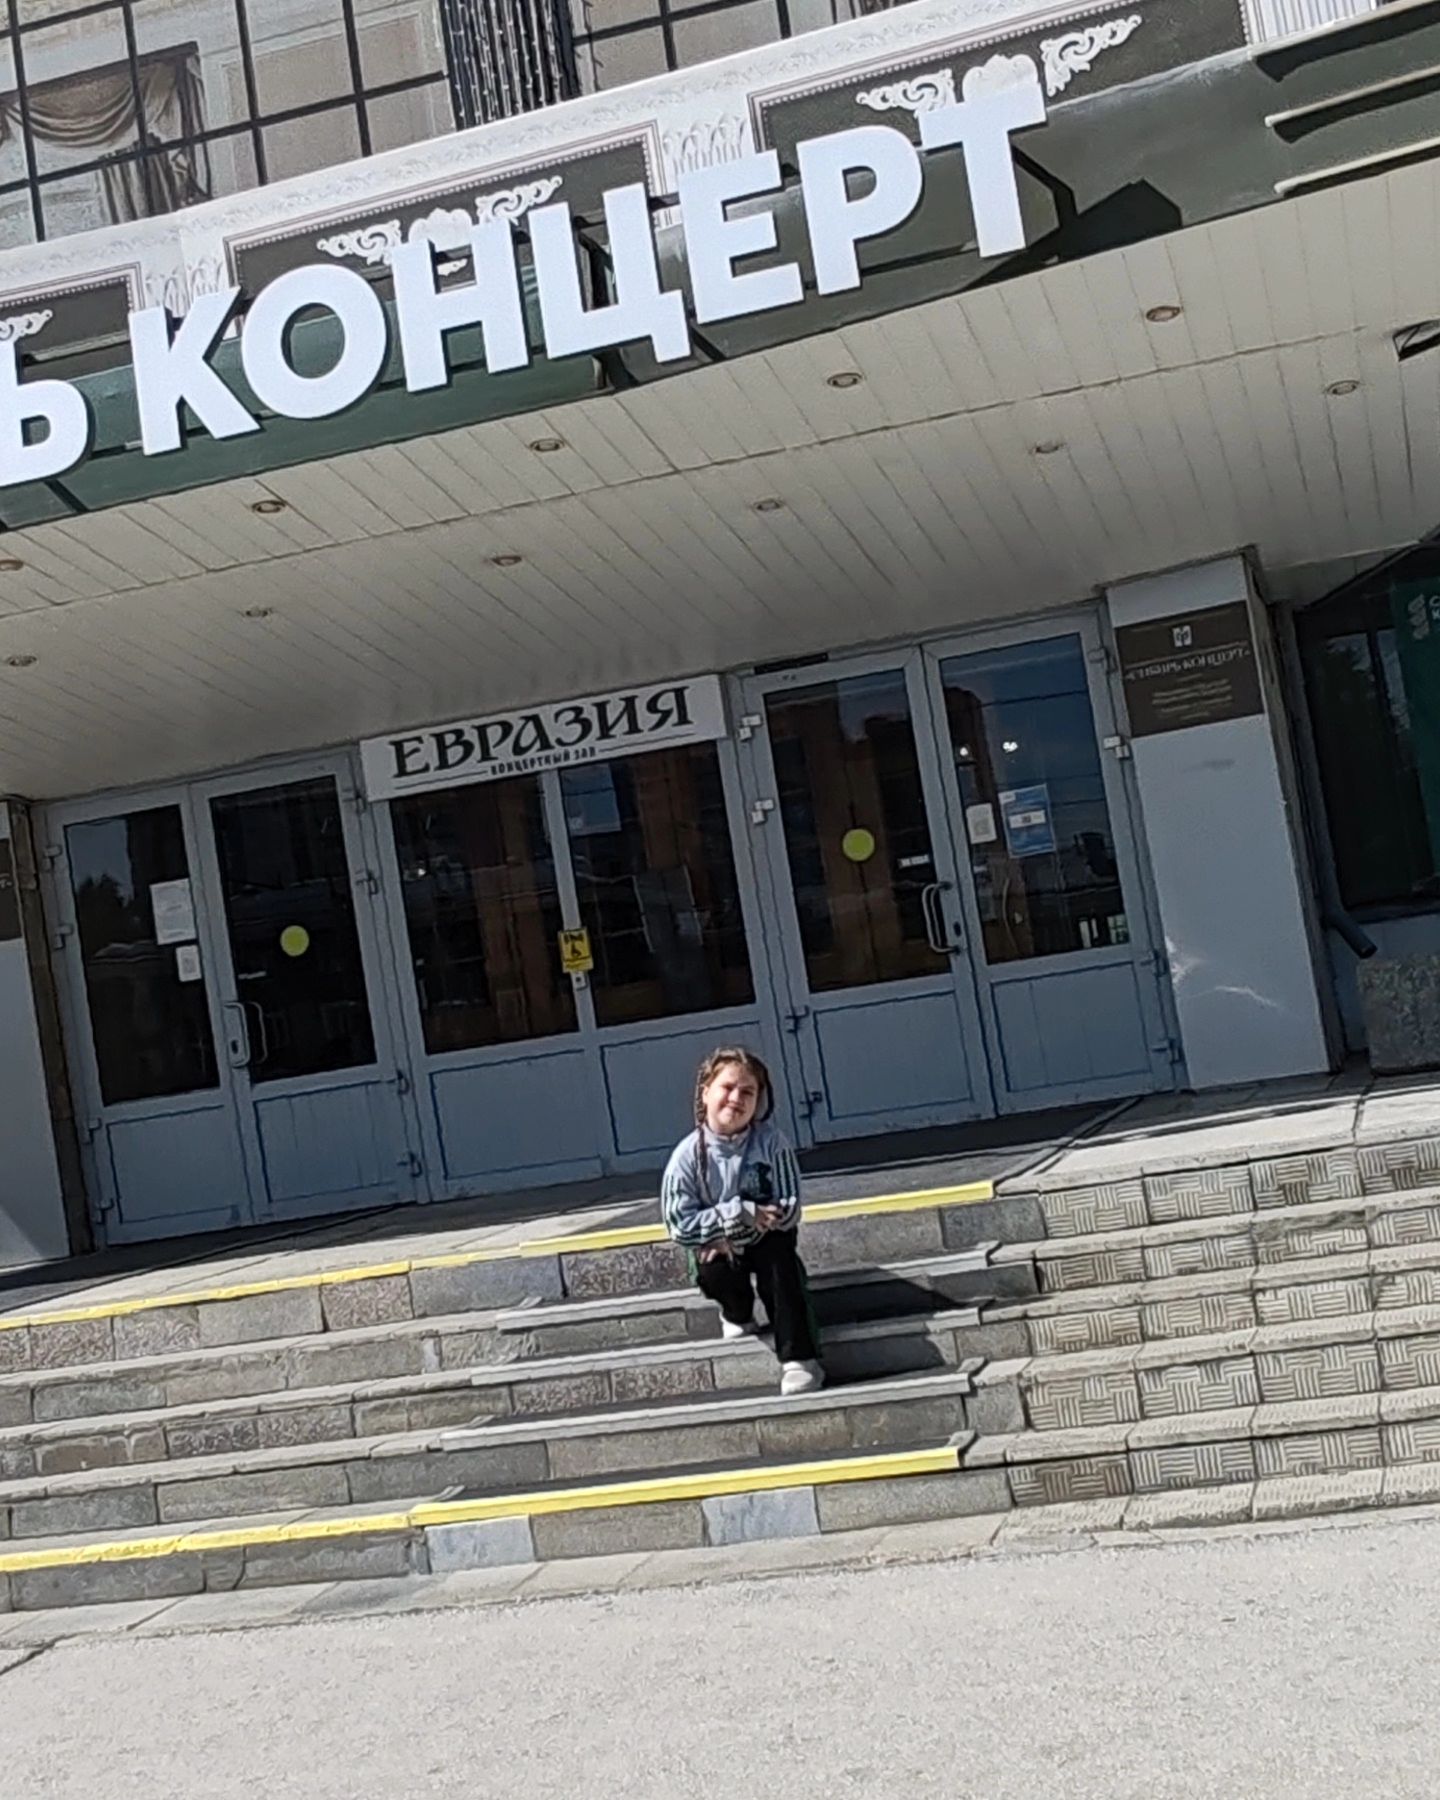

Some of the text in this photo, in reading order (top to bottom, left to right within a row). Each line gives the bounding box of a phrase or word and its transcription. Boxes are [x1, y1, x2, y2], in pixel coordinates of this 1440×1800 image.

[128, 80, 1047, 456] КОНЦЕРТ
[389, 684, 693, 778] ЕВРАЗИЯ
[491, 746, 597, 776] КОНЦЕРТНЫЙ ЗАЛ
